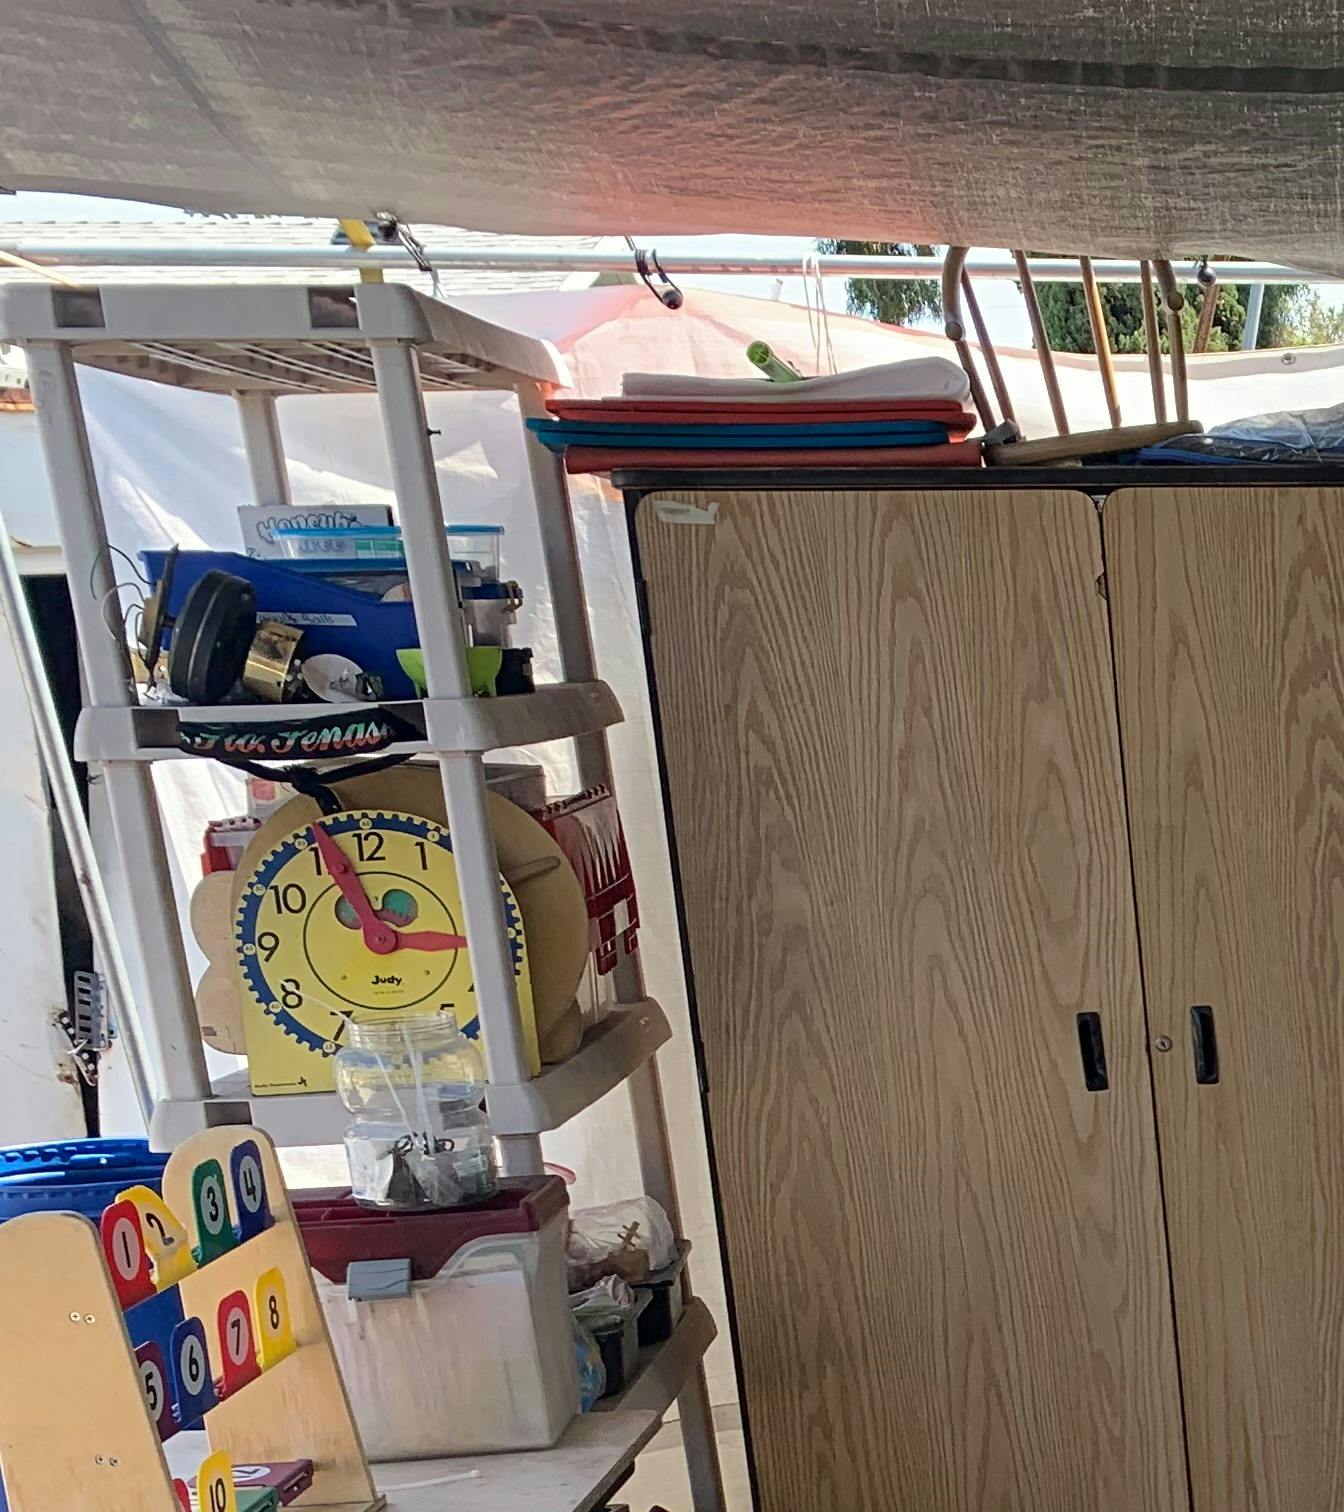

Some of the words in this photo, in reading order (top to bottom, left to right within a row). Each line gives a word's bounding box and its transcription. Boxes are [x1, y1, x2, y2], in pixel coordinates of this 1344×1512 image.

[352, 831, 386, 862] 12
[414, 841, 428, 870] 1
[269, 883, 307, 914] 10
[257, 931, 280, 963] 9
[280, 978, 303, 1009] 8
[371, 975, 403, 986] Judy
[329, 1010, 353, 1042] 7
[122, 1231, 132, 1269] 1
[145, 1212, 175, 1246] 2
[206, 1185, 219, 1222] 3
[243, 1168, 257, 1203] 4
[144, 1371, 157, 1411] 5
[188, 1345, 199, 1383] 6
[230, 1318, 241, 1356] 7
[268, 1295, 280, 1330] 8
